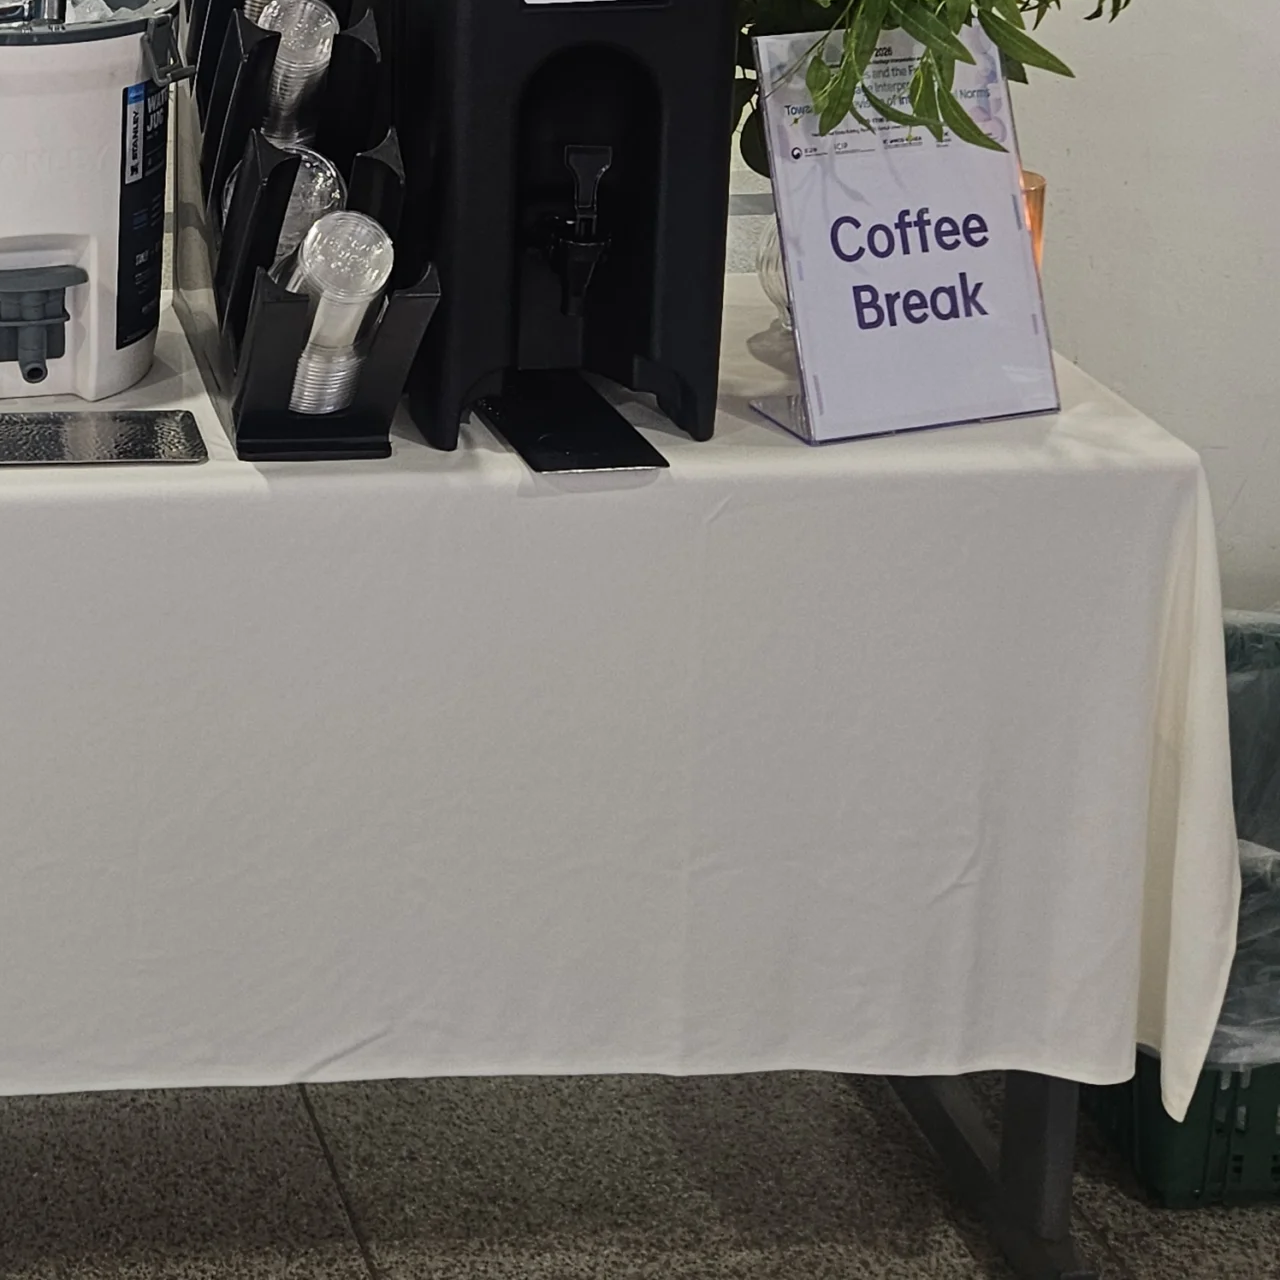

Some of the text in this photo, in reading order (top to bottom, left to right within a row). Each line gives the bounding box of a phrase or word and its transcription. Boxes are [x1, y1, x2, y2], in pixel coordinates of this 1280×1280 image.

[872, 65, 907, 79] and the
[146, 107, 165, 132] JUG
[784, 104, 813, 116] Towa
[959, 87, 991, 100] Norms
[131, 111, 139, 160] STANLEY
[830, 207, 989, 262] Coffee
[852, 272, 989, 330] Break
